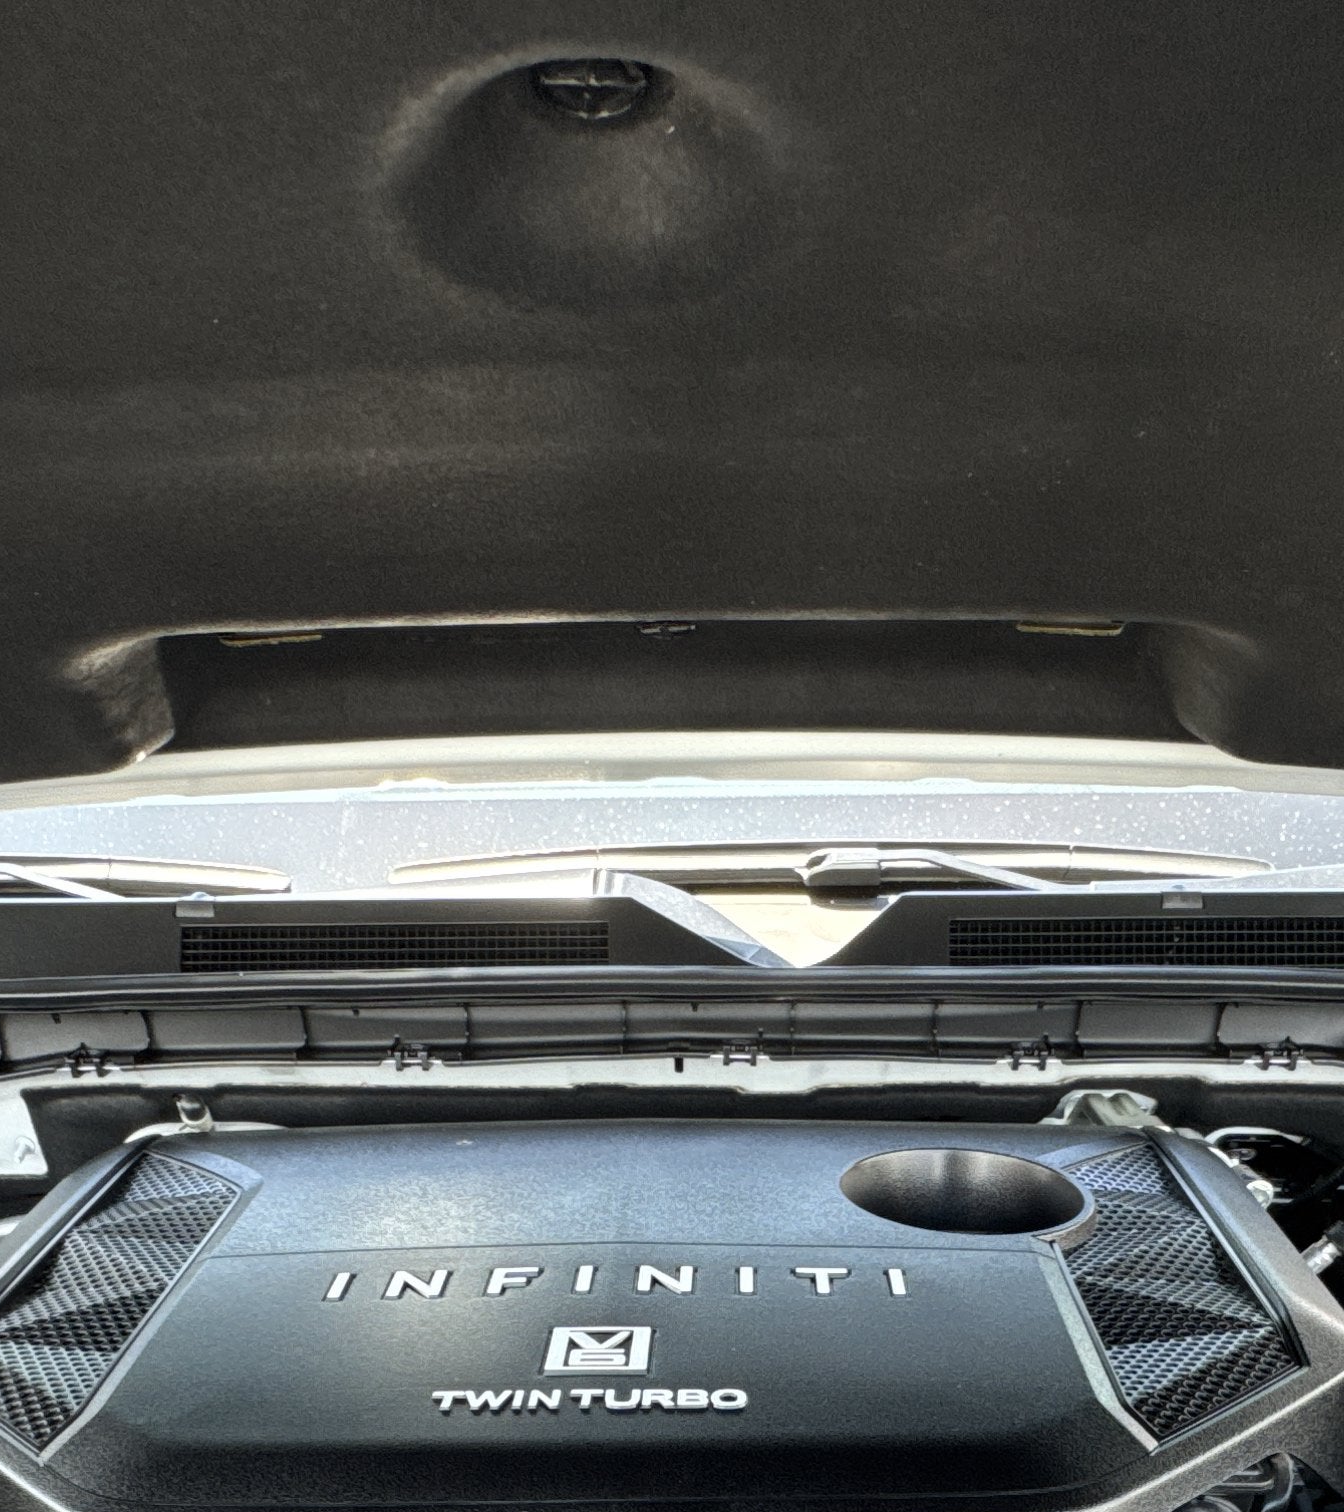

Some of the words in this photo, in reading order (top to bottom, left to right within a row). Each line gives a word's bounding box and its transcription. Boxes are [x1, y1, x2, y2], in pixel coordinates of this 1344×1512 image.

[325, 1264, 908, 1299] INFINITI
[431, 1388, 562, 1412] TWIN
[569, 1388, 748, 1411] TURBO
